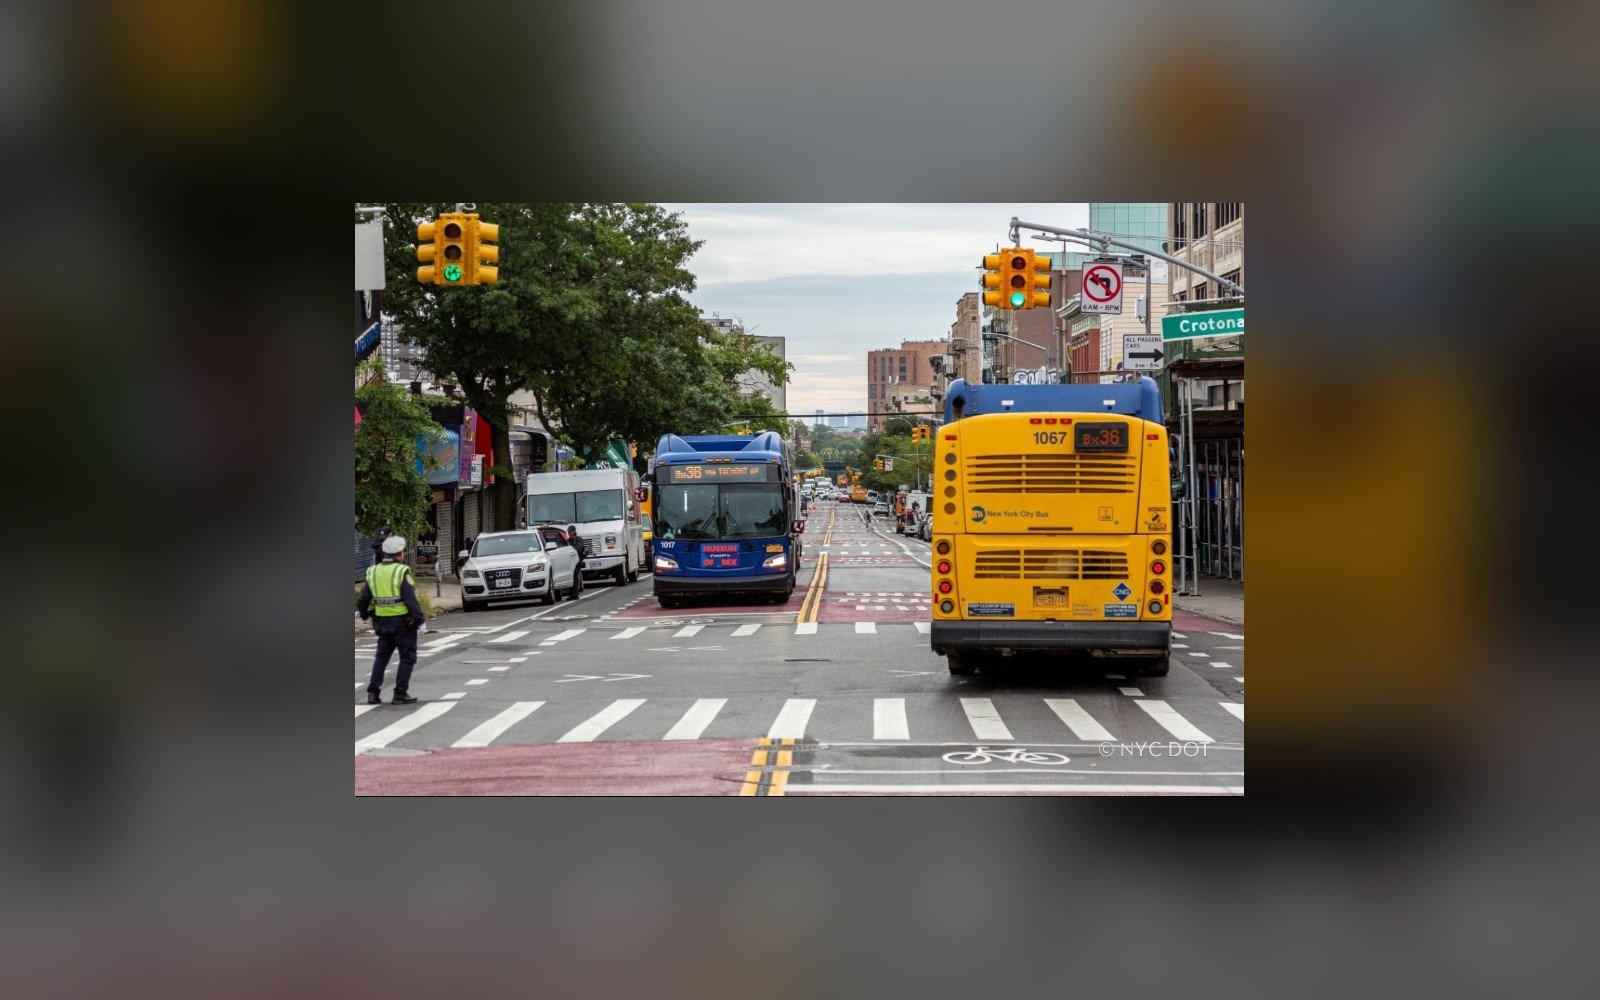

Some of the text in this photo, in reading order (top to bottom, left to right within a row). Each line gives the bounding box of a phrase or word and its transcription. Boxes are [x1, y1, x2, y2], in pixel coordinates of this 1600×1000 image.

[1180, 318, 1244, 333] Crotona
[1033, 432, 1067, 444] 1067
[1083, 429, 1120, 445] Bx36
